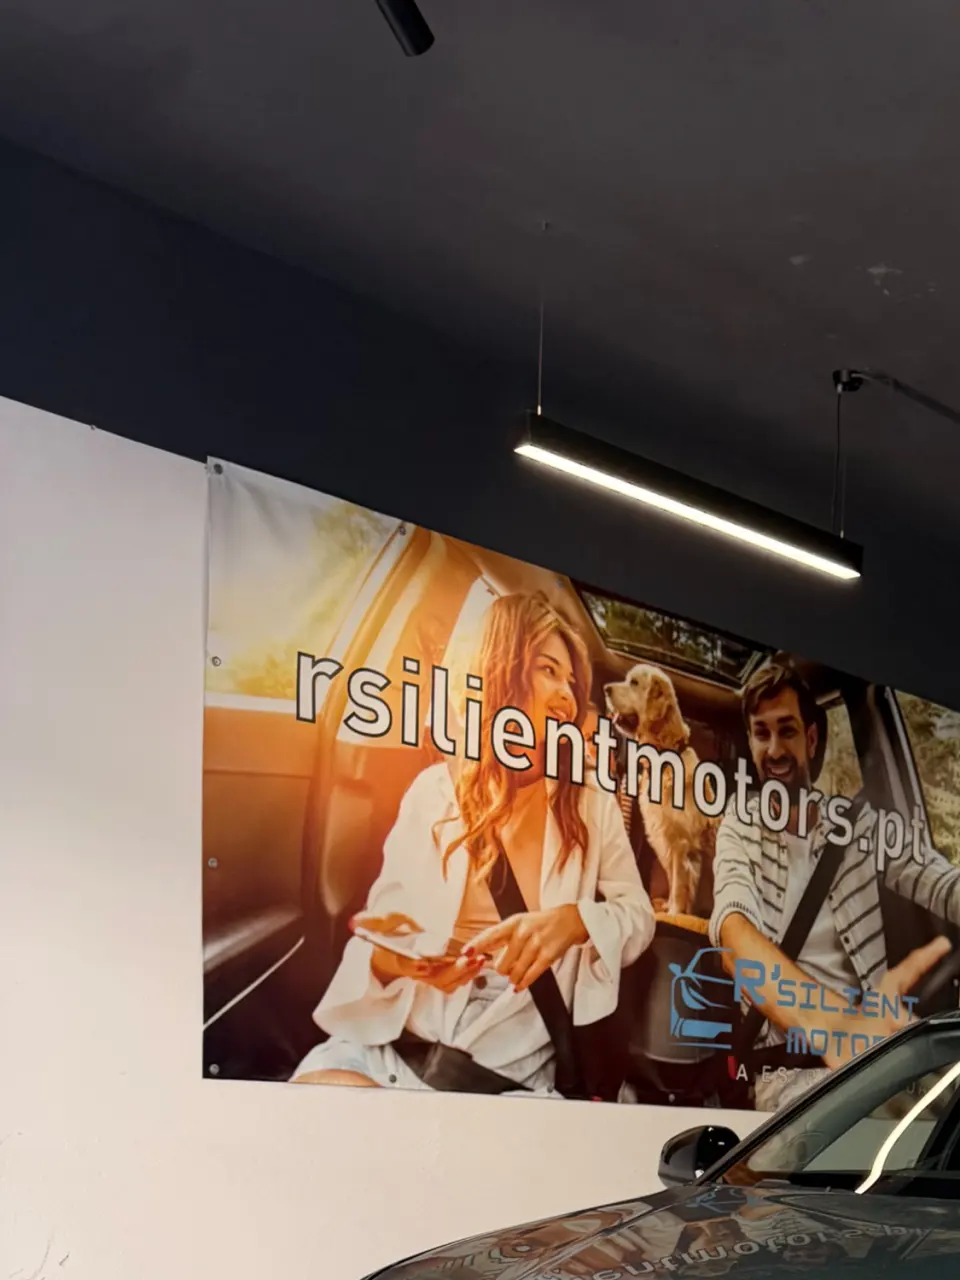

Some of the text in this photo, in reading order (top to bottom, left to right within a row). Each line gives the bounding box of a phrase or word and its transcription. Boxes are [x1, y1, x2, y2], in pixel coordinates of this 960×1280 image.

[296, 651, 926, 872] rsilientmotors.pt
[733, 959, 920, 1020] R'SILIENT
[786, 1026, 886, 1057] MOTO
[736, 1063, 822, 1086] A ESTR
